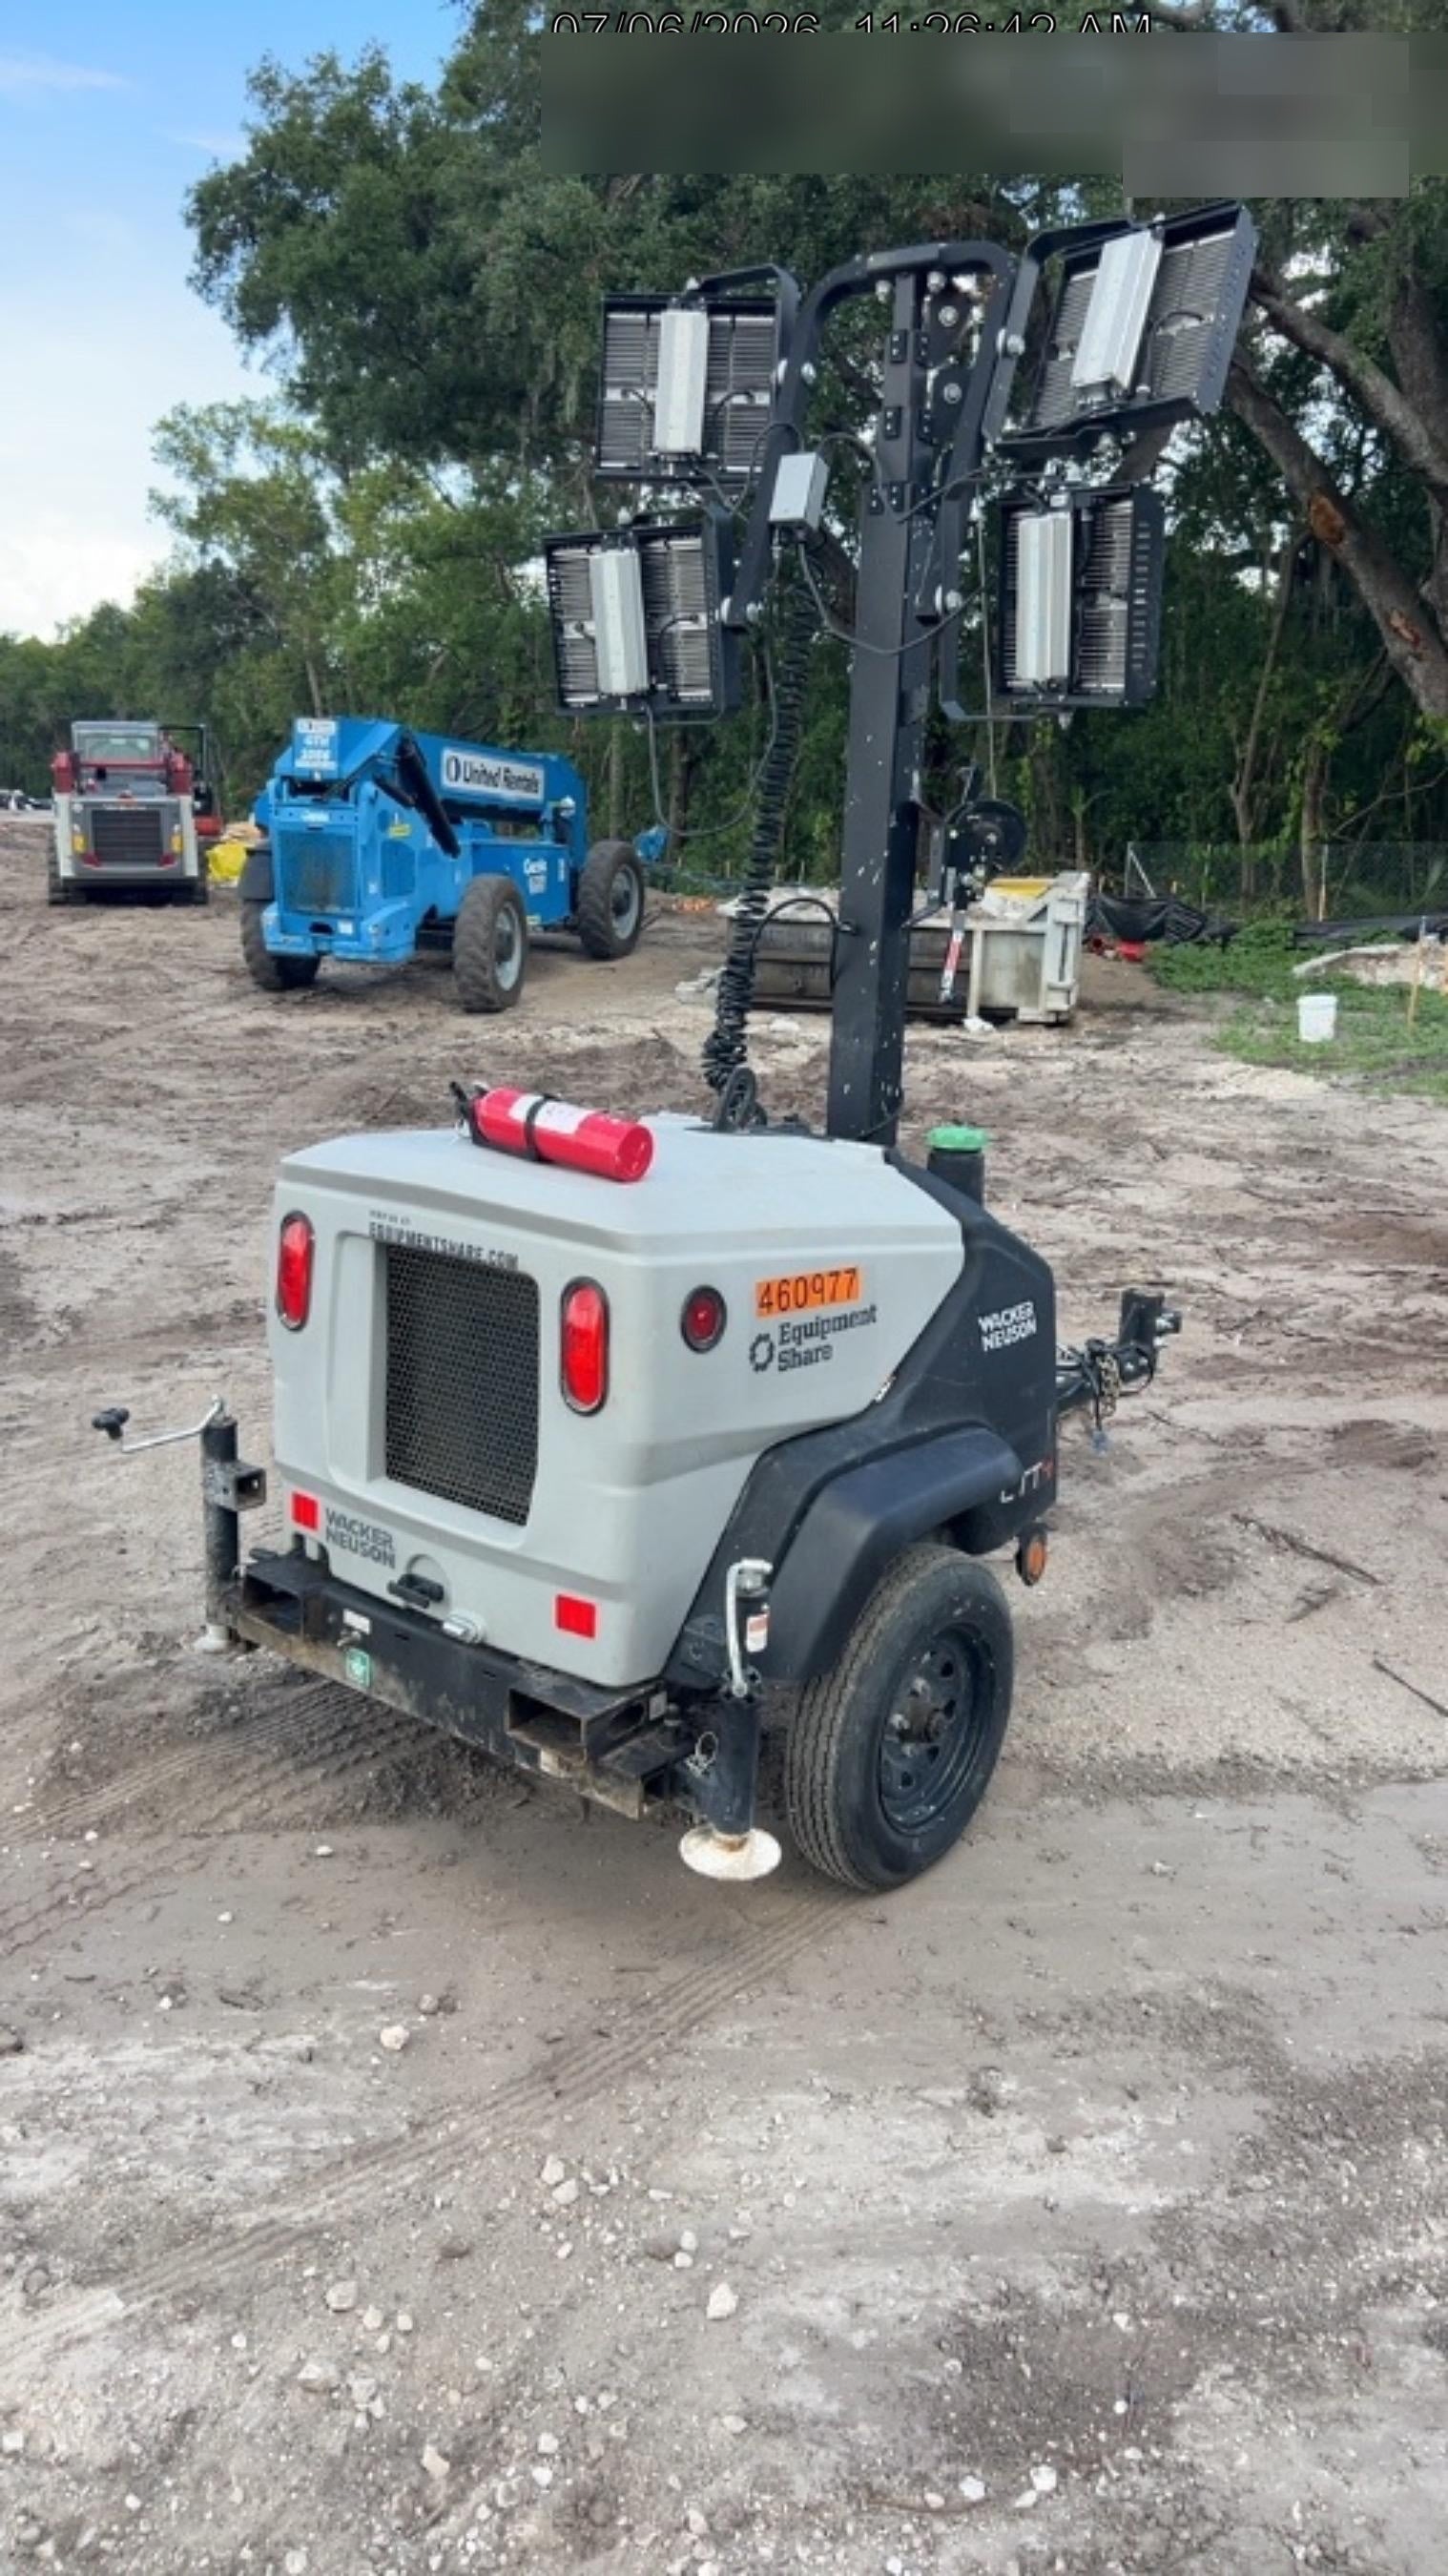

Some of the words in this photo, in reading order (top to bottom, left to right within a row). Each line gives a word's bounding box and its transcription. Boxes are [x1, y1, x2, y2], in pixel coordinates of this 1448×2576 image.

[463, 759, 501, 788] United
[503, 766, 540, 795] Rentals
[757, 1267, 858, 1314] 460977
[777, 1303, 877, 1346] Equipment
[977, 1300, 1034, 1334] WACKER
[981, 1318, 1037, 1352] NEUSON
[777, 1343, 833, 1372] Share
[325, 1507, 393, 1549] WACKER
[325, 1526, 396, 1569] NEUSON
